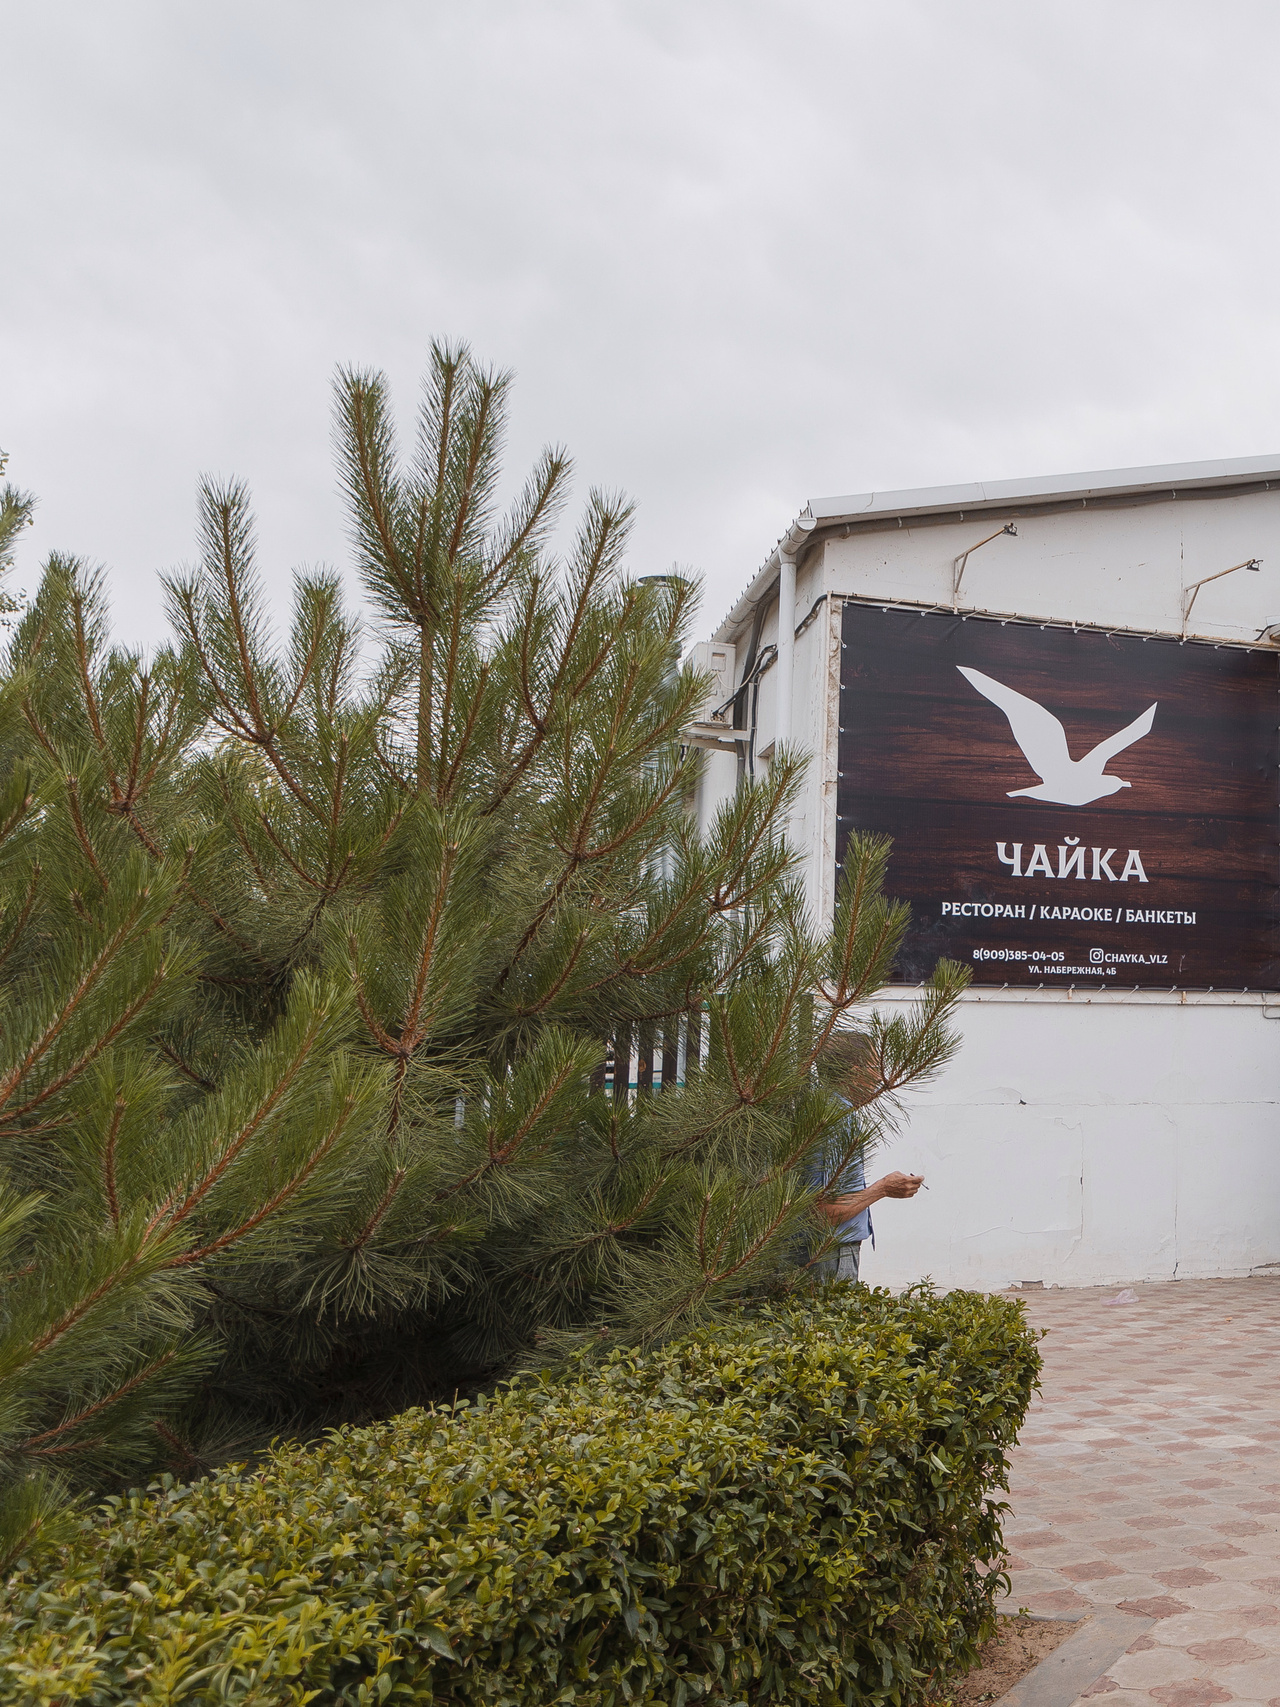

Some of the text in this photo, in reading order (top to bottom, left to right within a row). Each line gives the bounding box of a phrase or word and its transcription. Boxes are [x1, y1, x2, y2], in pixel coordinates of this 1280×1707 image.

[995, 836, 1149, 883] ЧАЙКА
[941, 902, 1026, 919] РЕСТОРАН
[1040, 905, 1113, 922] КАРАОКЕ
[1125, 909, 1197, 925] БАНКЕТЫ
[973, 948, 1065, 962] 8(909)385-04-05
[1105, 953, 1168, 964] CHAYKA_VLZ
[1028, 965, 1117, 976] УЛ. НАБЕРЕЖНАЯ, 4Б
